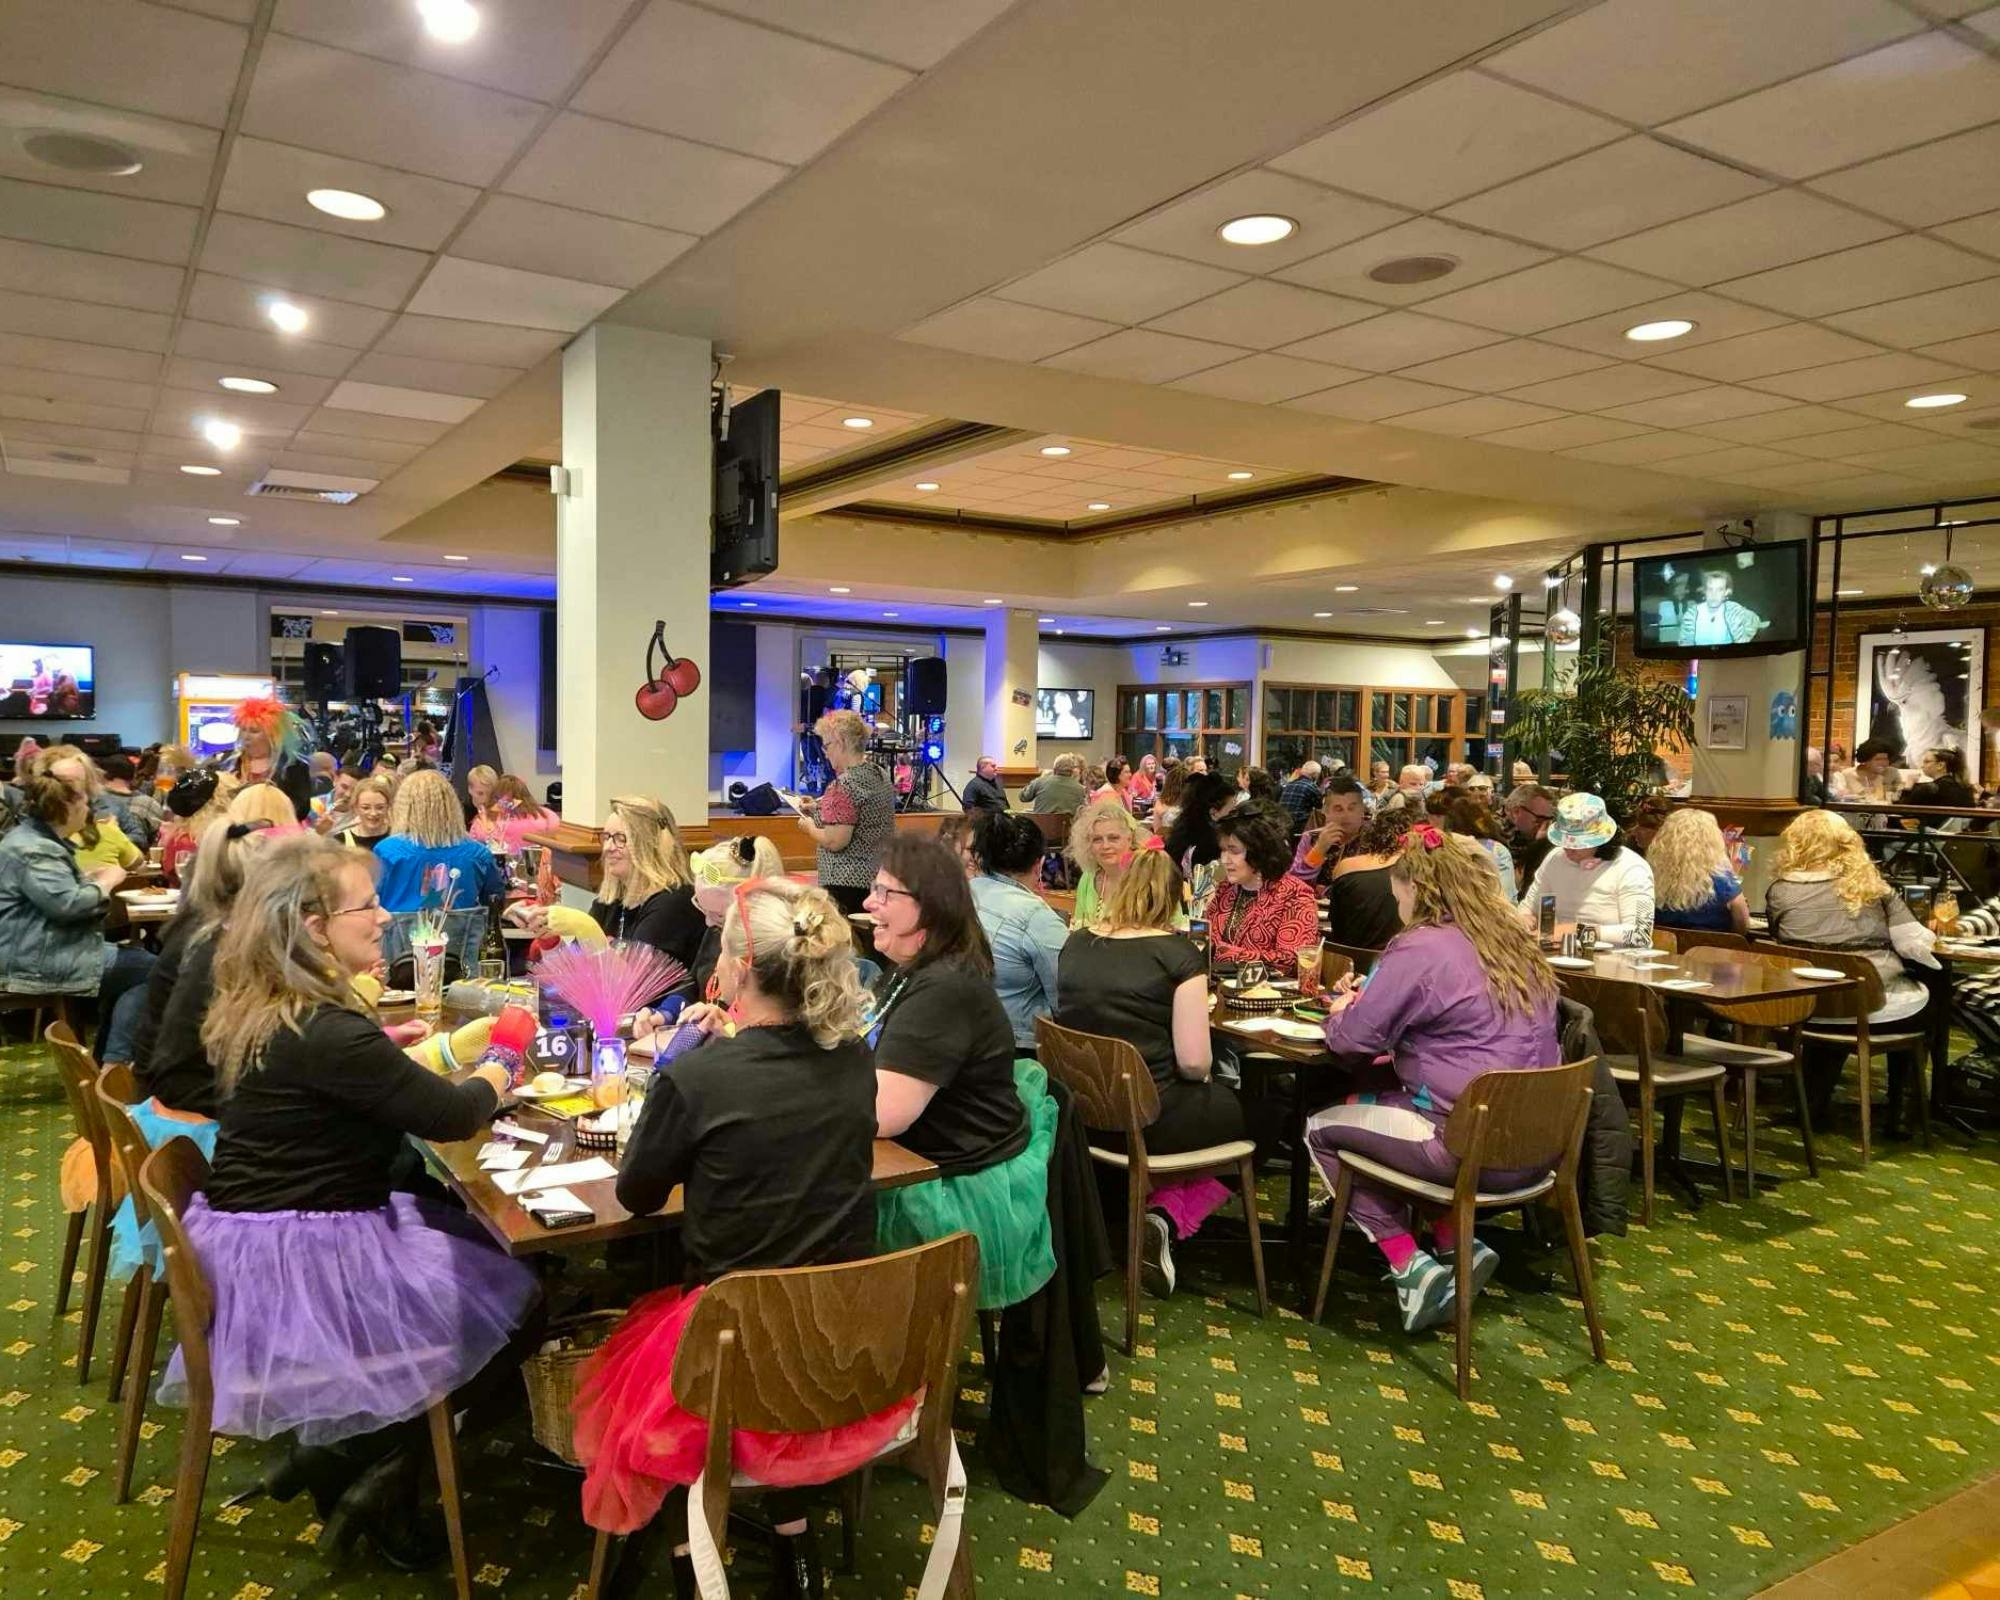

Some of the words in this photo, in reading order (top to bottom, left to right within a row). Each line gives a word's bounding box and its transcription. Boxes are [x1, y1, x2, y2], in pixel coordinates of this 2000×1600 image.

[1583, 931, 1595, 943] 18
[1245, 967, 1263, 983] 17
[536, 1035, 567, 1057] 16
